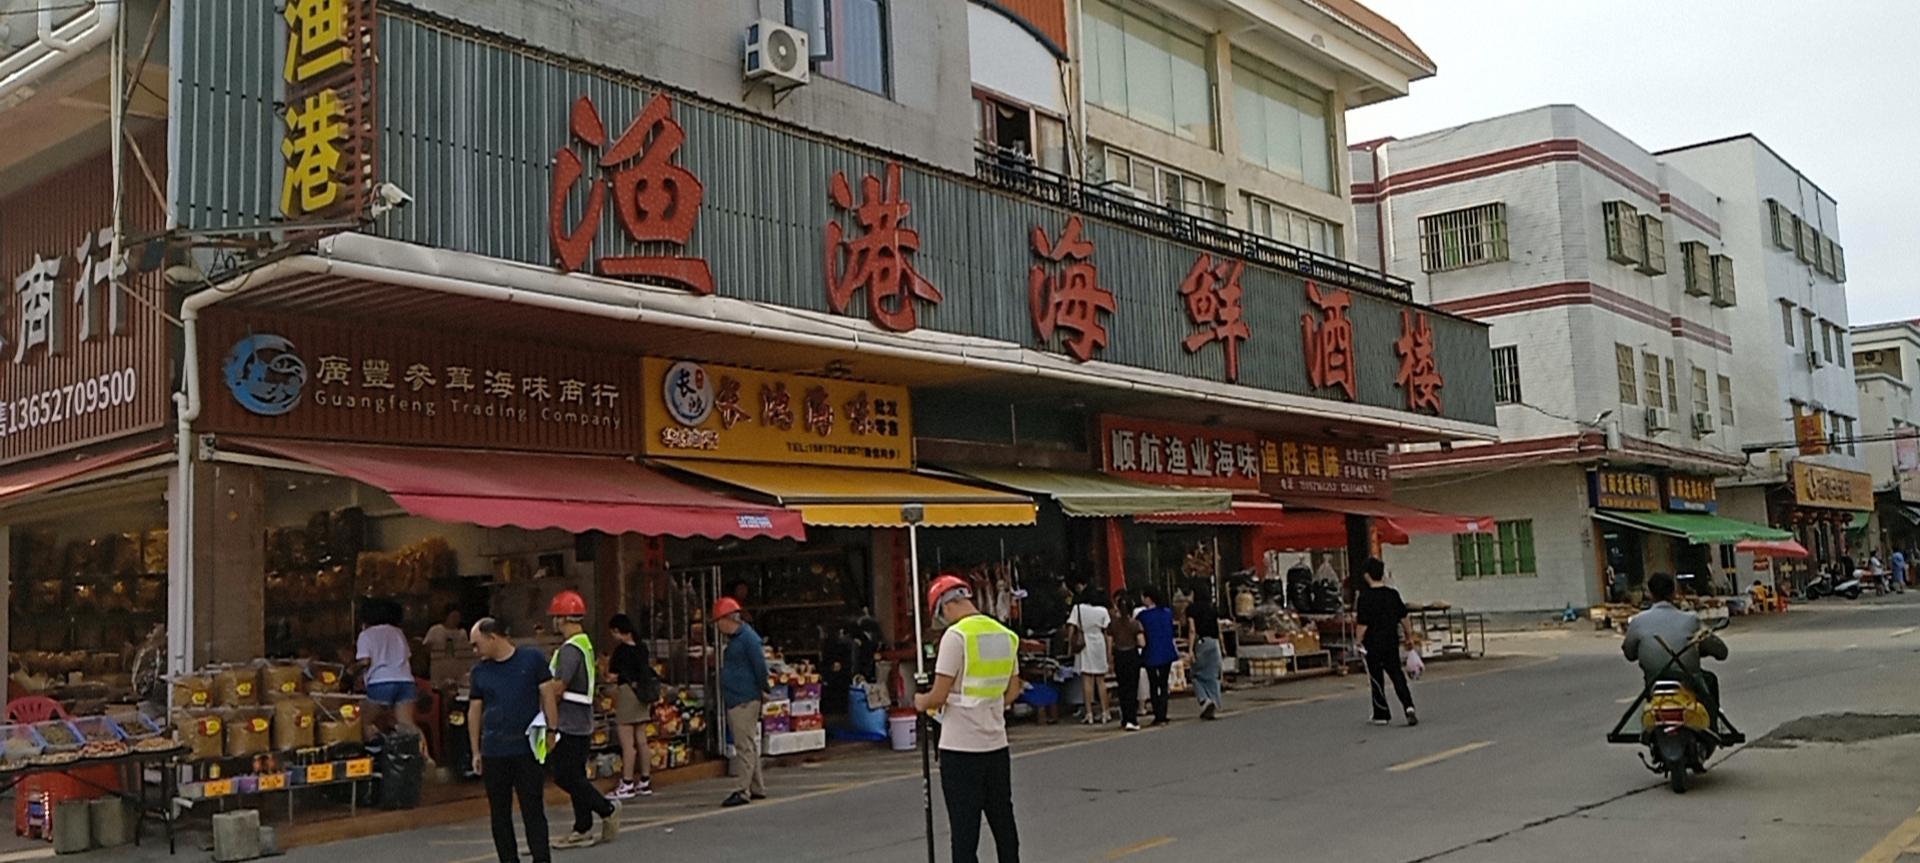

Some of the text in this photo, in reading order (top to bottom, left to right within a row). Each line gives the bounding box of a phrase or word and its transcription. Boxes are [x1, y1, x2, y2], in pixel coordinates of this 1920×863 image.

[0, 225, 130, 365] 商行
[549, 92, 1445, 416] 渔港海鲜酒楼
[315, 389, 621, 429] Guangfeng Trading Company
[1111, 429, 1257, 479] 顺航渔业海味
